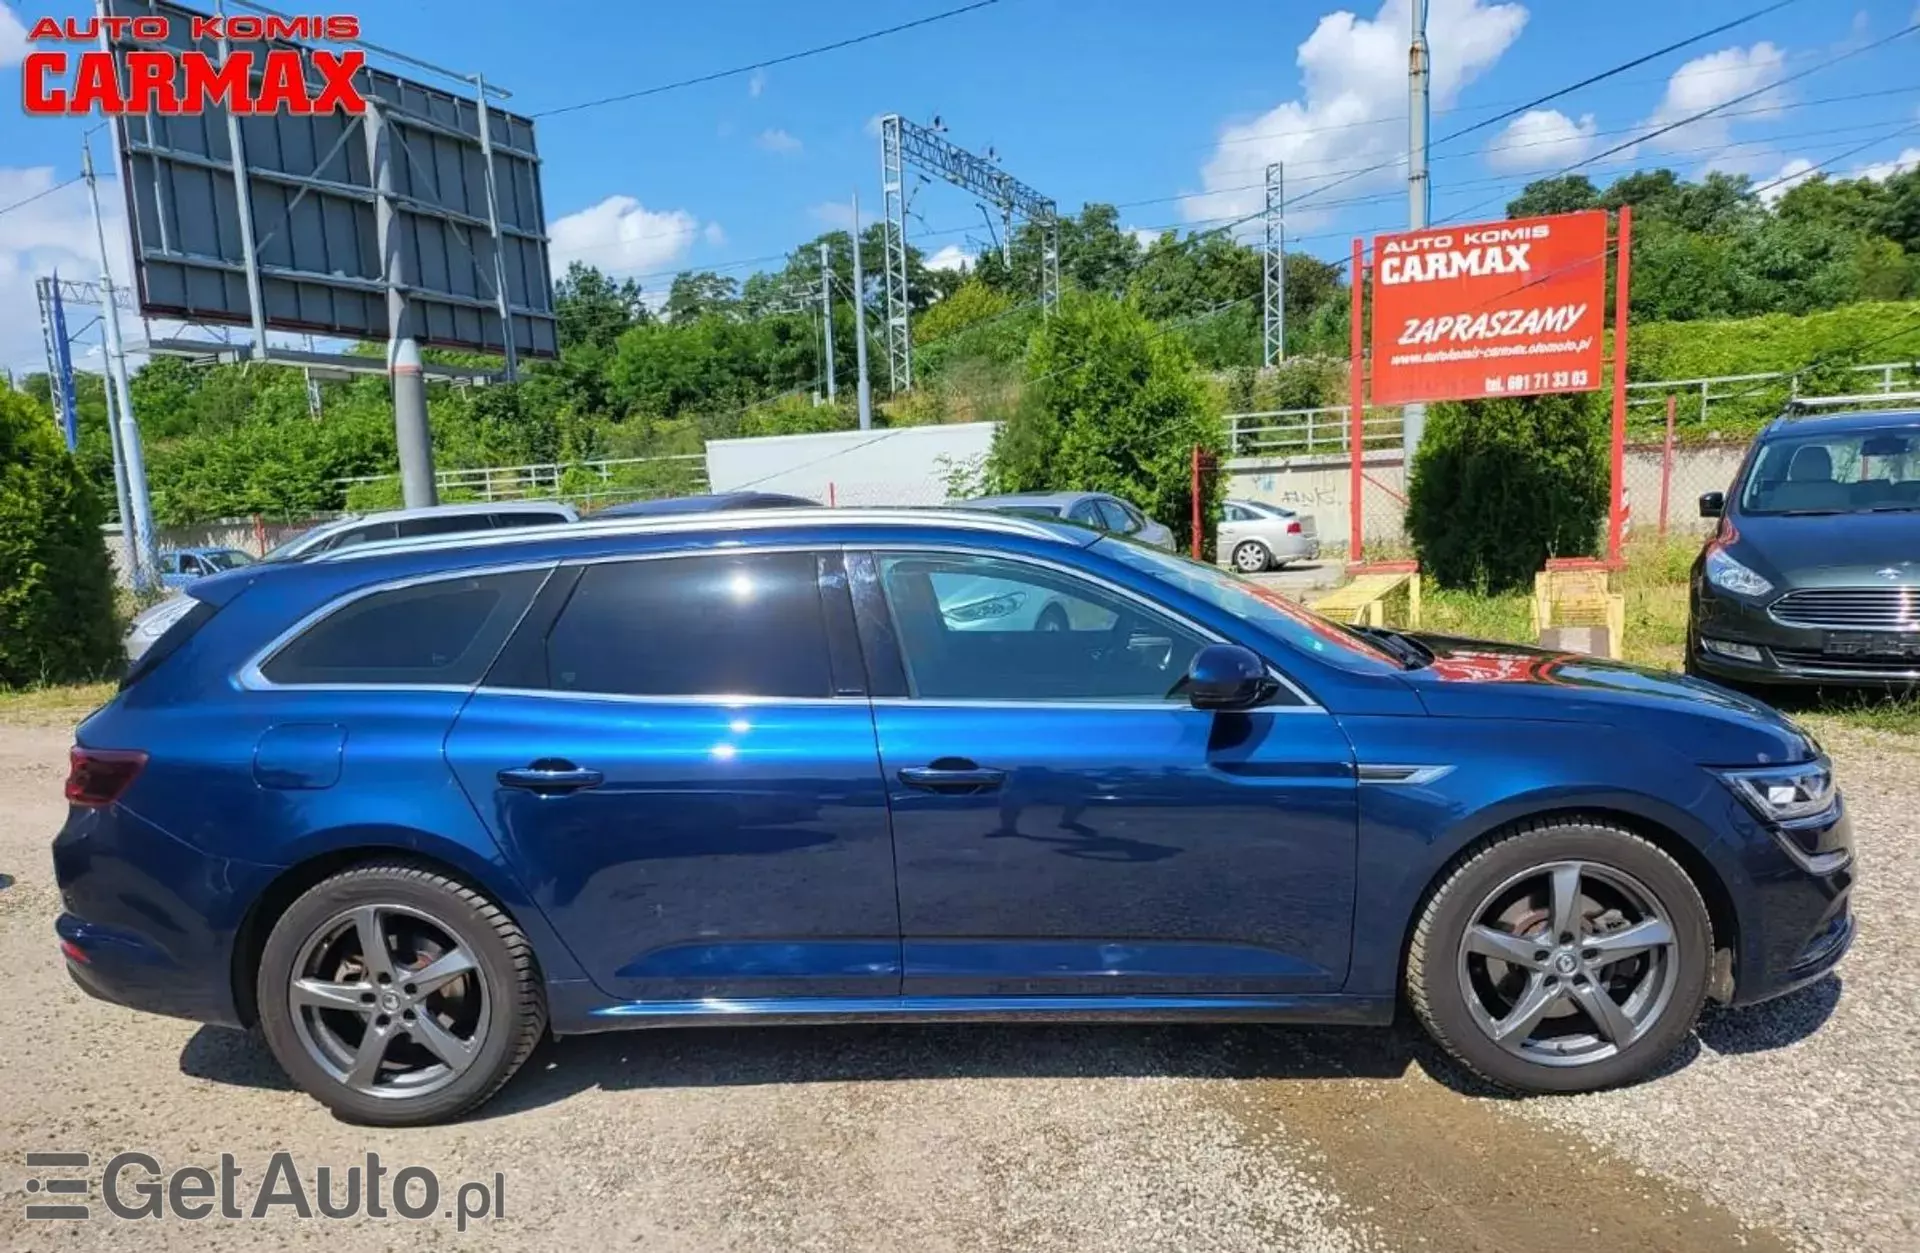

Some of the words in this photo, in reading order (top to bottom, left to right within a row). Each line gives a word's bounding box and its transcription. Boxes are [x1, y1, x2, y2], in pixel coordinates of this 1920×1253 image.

[1383, 235, 1452, 254] AUTO
[1464, 224, 1550, 245] KOMIS
[1381, 244, 1530, 284] CARMAX
[1398, 304, 1587, 345] ZAPRASZAMY
[1534, 372, 1549, 390] 71
